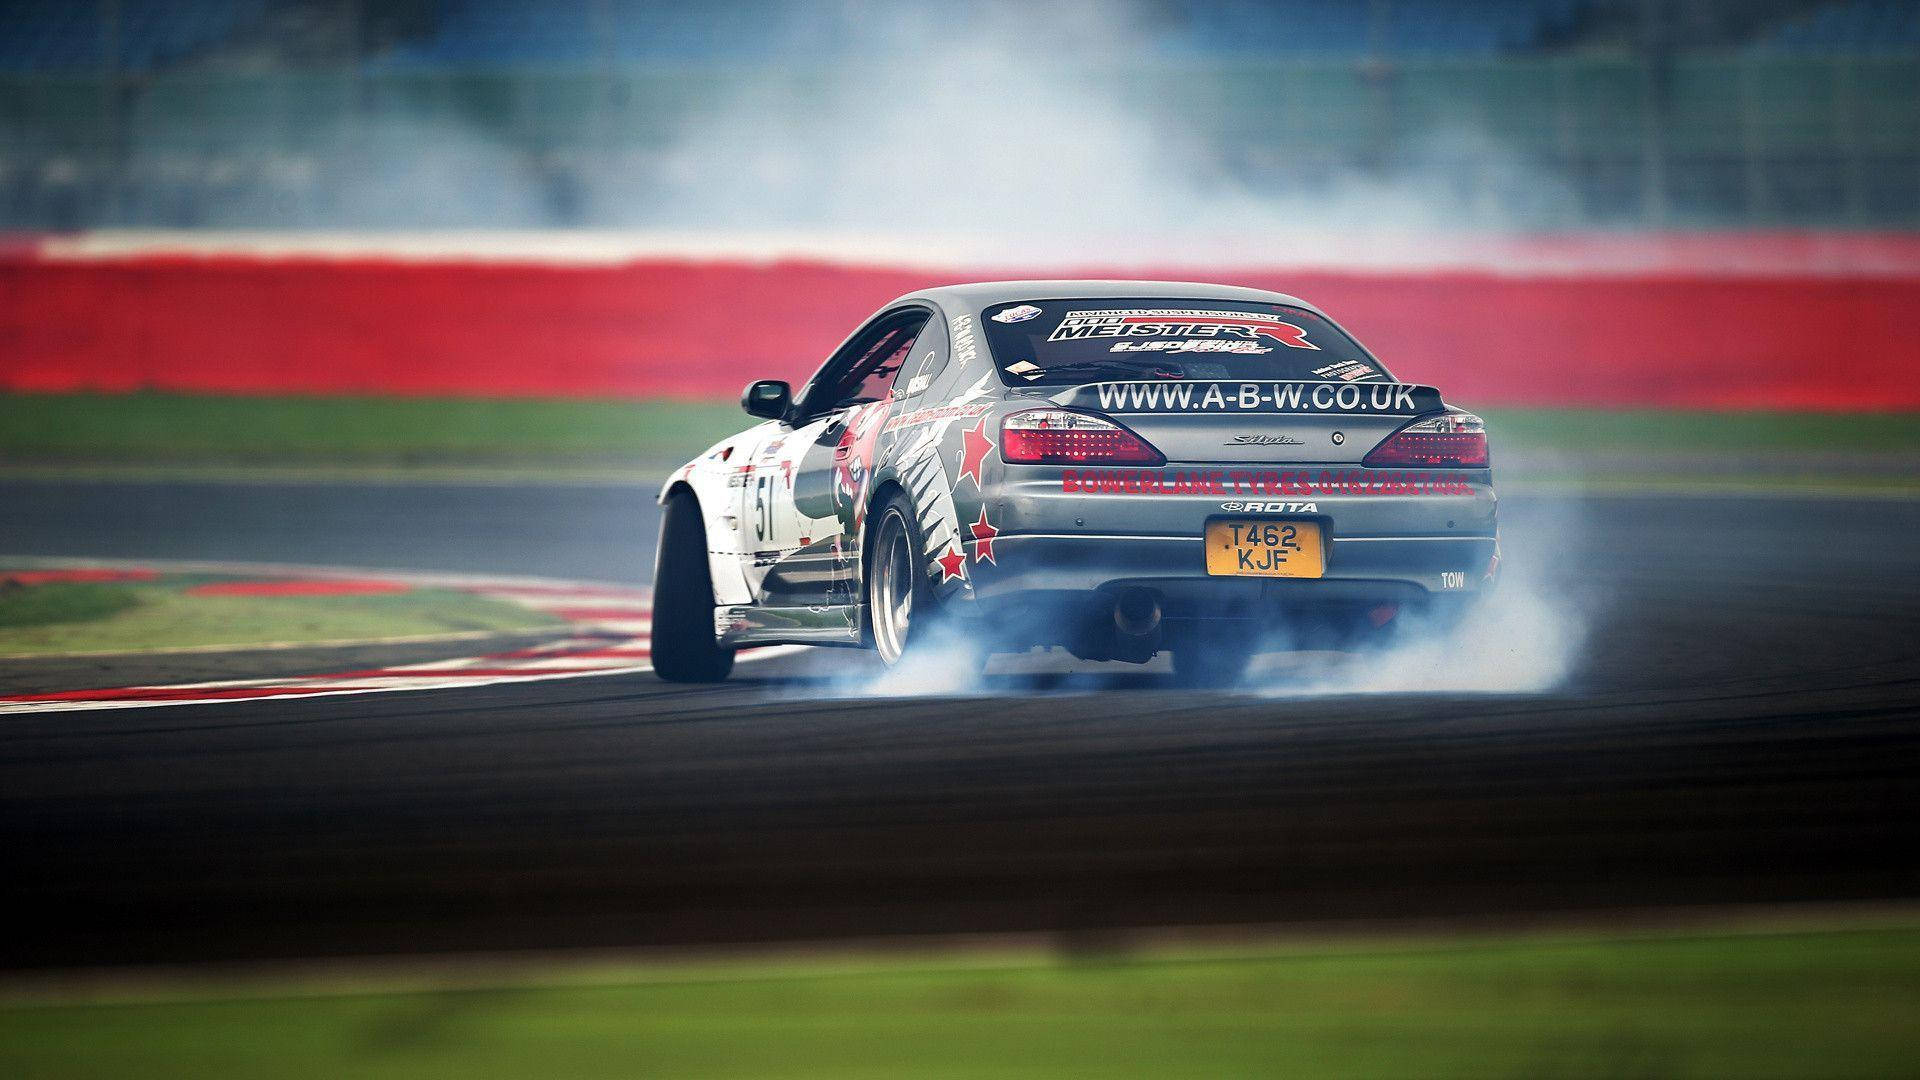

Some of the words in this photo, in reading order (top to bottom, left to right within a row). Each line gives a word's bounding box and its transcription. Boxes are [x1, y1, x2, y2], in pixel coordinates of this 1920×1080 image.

[1097, 383, 1416, 410] WWW.A-B-W.CO.UK
[1226, 434, 1304, 446] Silvia
[1062, 470, 1227, 495] BOWERLANE
[756, 475, 774, 542] 51
[1243, 502, 1318, 513] ROTA
[1228, 524, 1297, 548] T462
[1237, 549, 1288, 570] KJF
[1441, 571, 1464, 588] TOW
